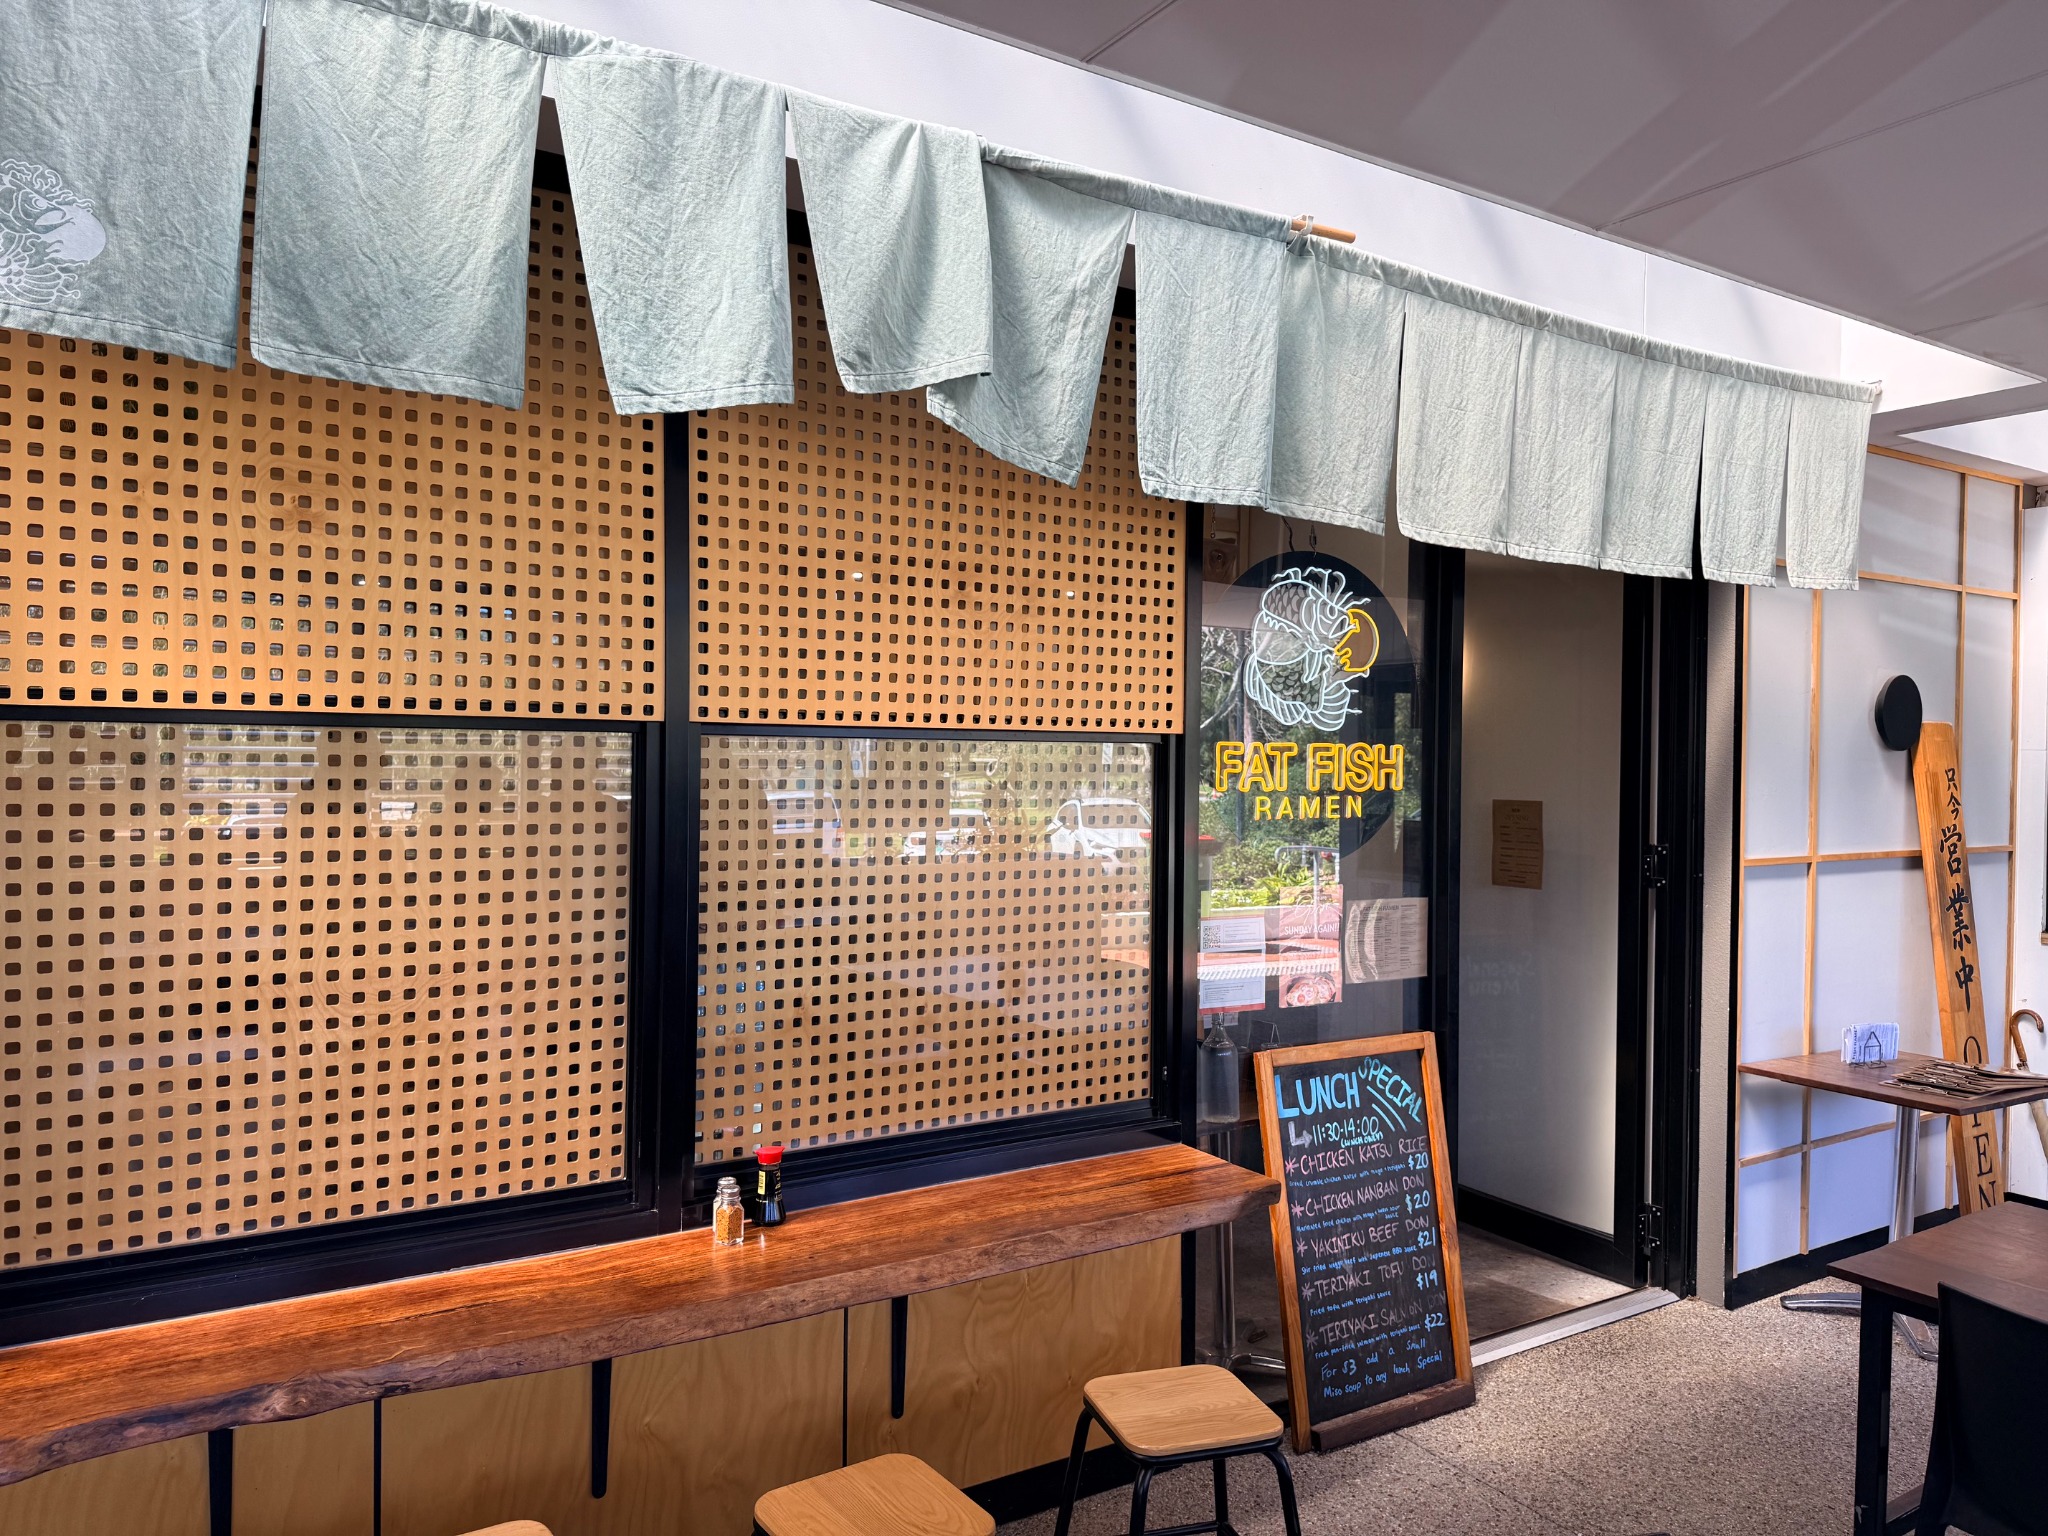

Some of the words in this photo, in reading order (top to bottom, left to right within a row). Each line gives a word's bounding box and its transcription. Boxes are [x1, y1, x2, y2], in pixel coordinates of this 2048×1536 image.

[1215, 741, 1298, 793] FAT
[1305, 742, 1404, 792] FISH
[1254, 796, 1362, 821] RAMEN
[1940, 767, 1974, 1014] 只今営業中
[1284, 925, 1312, 936] SUNDAY
[1275, 1072, 1360, 1118] LUNCH
[1358, 1057, 1423, 1122] SPECIAL
[1301, 1148, 1354, 1174] CHICKEN
[1359, 1144, 1392, 1163] KATSU
[1399, 1136, 1427, 1154] RICE
[1408, 1152, 1429, 1170] $20
[1306, 1190, 1355, 1217] CHICKEN
[1357, 1178, 1399, 1204] NANBAN
[1403, 1173, 1425, 1190] DON
[1405, 1190, 1430, 1214] $20
[1311, 1230, 1365, 1258] YAKINIKU
[1369, 1222, 1399, 1243] BEEF
[1405, 1215, 1429, 1232] DON
[1417, 1227, 1436, 1249] $21
[1314, 1270, 1372, 1299] TERIYAKI
[1378, 1261, 1404, 1282] TOFU
[1416, 1269, 1438, 1290] $19
[1319, 1314, 1379, 1344] TERIYAKI
[1424, 1313, 1446, 1332] $22
[1321, 1363, 1338, 1380] For
[1365, 1352, 1379, 1364] add
[1388, 1347, 1395, 1355] a
[1323, 1386, 1343, 1398] Miso
[1344, 1382, 1362, 1392] soup
[1365, 1374, 1373, 1385] to
[1375, 1372, 1387, 1383] any
[1393, 1363, 1411, 1374] lunch
